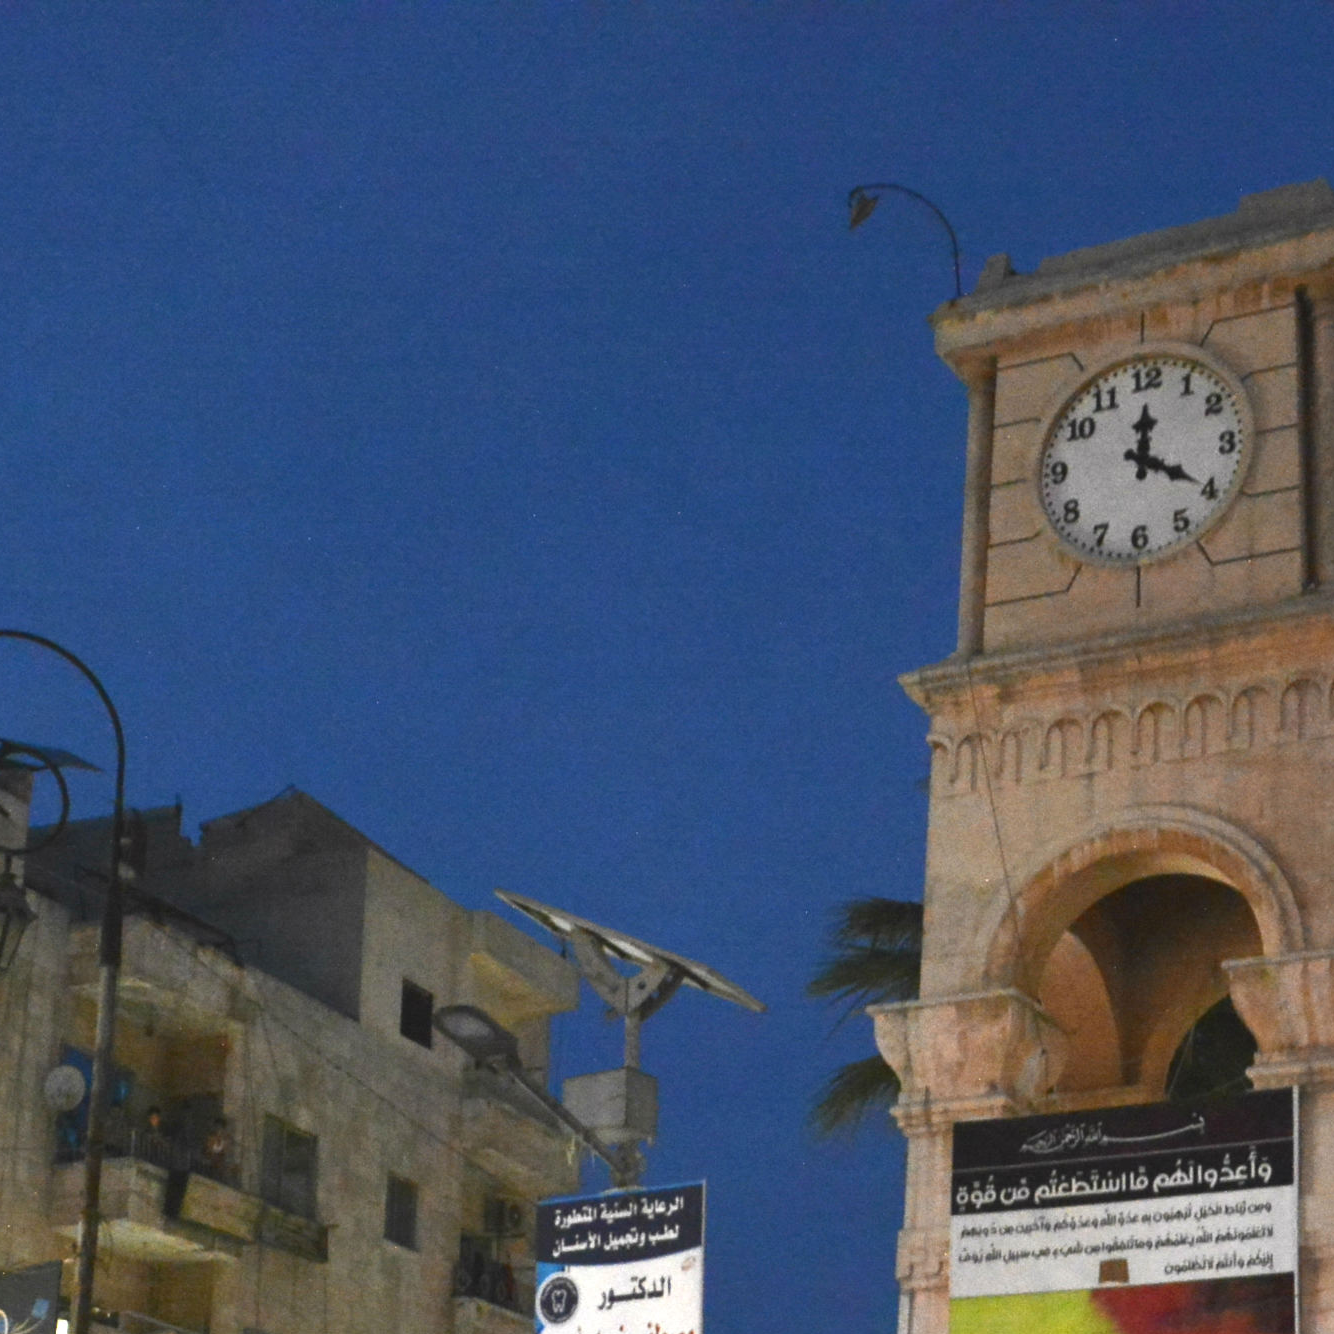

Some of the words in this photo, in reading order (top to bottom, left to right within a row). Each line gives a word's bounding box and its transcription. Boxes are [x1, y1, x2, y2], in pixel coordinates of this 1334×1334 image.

[1132, 367, 1162, 393] 12
[1181, 373, 1195, 397] 1
[1092, 387, 1119, 413] 11
[1205, 393, 1224, 417] 2
[1067, 417, 1096, 442] 10
[1218, 430, 1236, 454] 3
[1051, 461, 1069, 485] 9
[1201, 477, 1219, 500] 4
[1062, 499, 1080, 524] 8
[1173, 508, 1191, 533] 5
[1093, 522, 1110, 548] 7
[1131, 525, 1149, 550] 6
[598, 1275, 672, 1310] الدكتور
